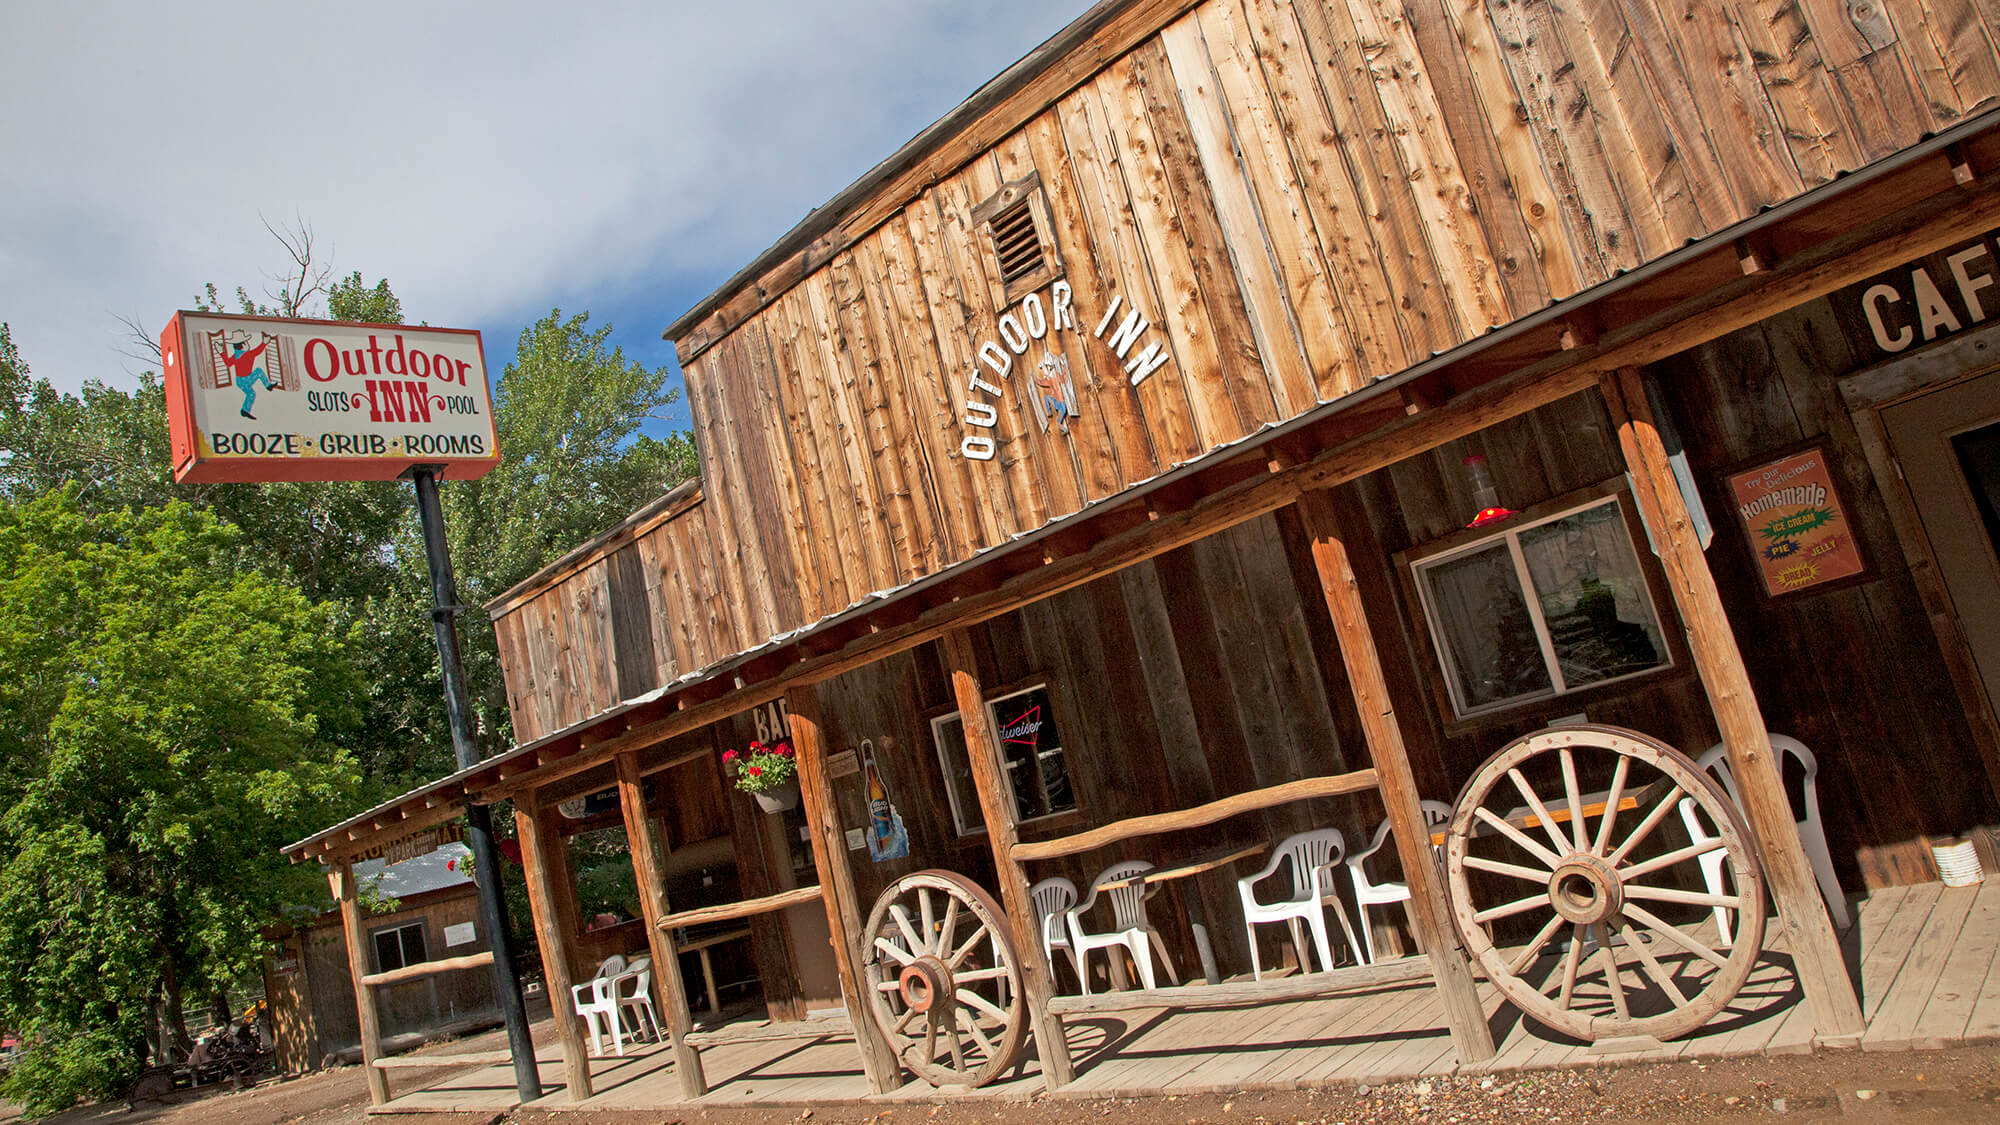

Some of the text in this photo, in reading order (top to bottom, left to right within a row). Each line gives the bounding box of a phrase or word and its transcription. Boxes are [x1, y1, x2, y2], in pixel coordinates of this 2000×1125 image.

[1862, 237, 2000, 352] CAF
[303, 334, 472, 387] Outdoor
[961, 279, 1169, 461] OUTDOOR INN
[307, 390, 350, 413] SLOTS
[364, 379, 432, 423] INN
[447, 395, 479, 415] POOL
[211, 432, 485, 455] BOOZE GRUB ROOMS
[1745, 468, 1780, 490] Try Our
[1766, 459, 1816, 489] Delicious
[1739, 482, 1827, 521] Homemade
[1772, 512, 1816, 533] ICE CREAM
[1771, 543, 1791, 556] PIE
[1811, 539, 1837, 557] JELLY
[1783, 567, 1812, 582] BREAD
[999, 720, 1043, 740] dweiser
